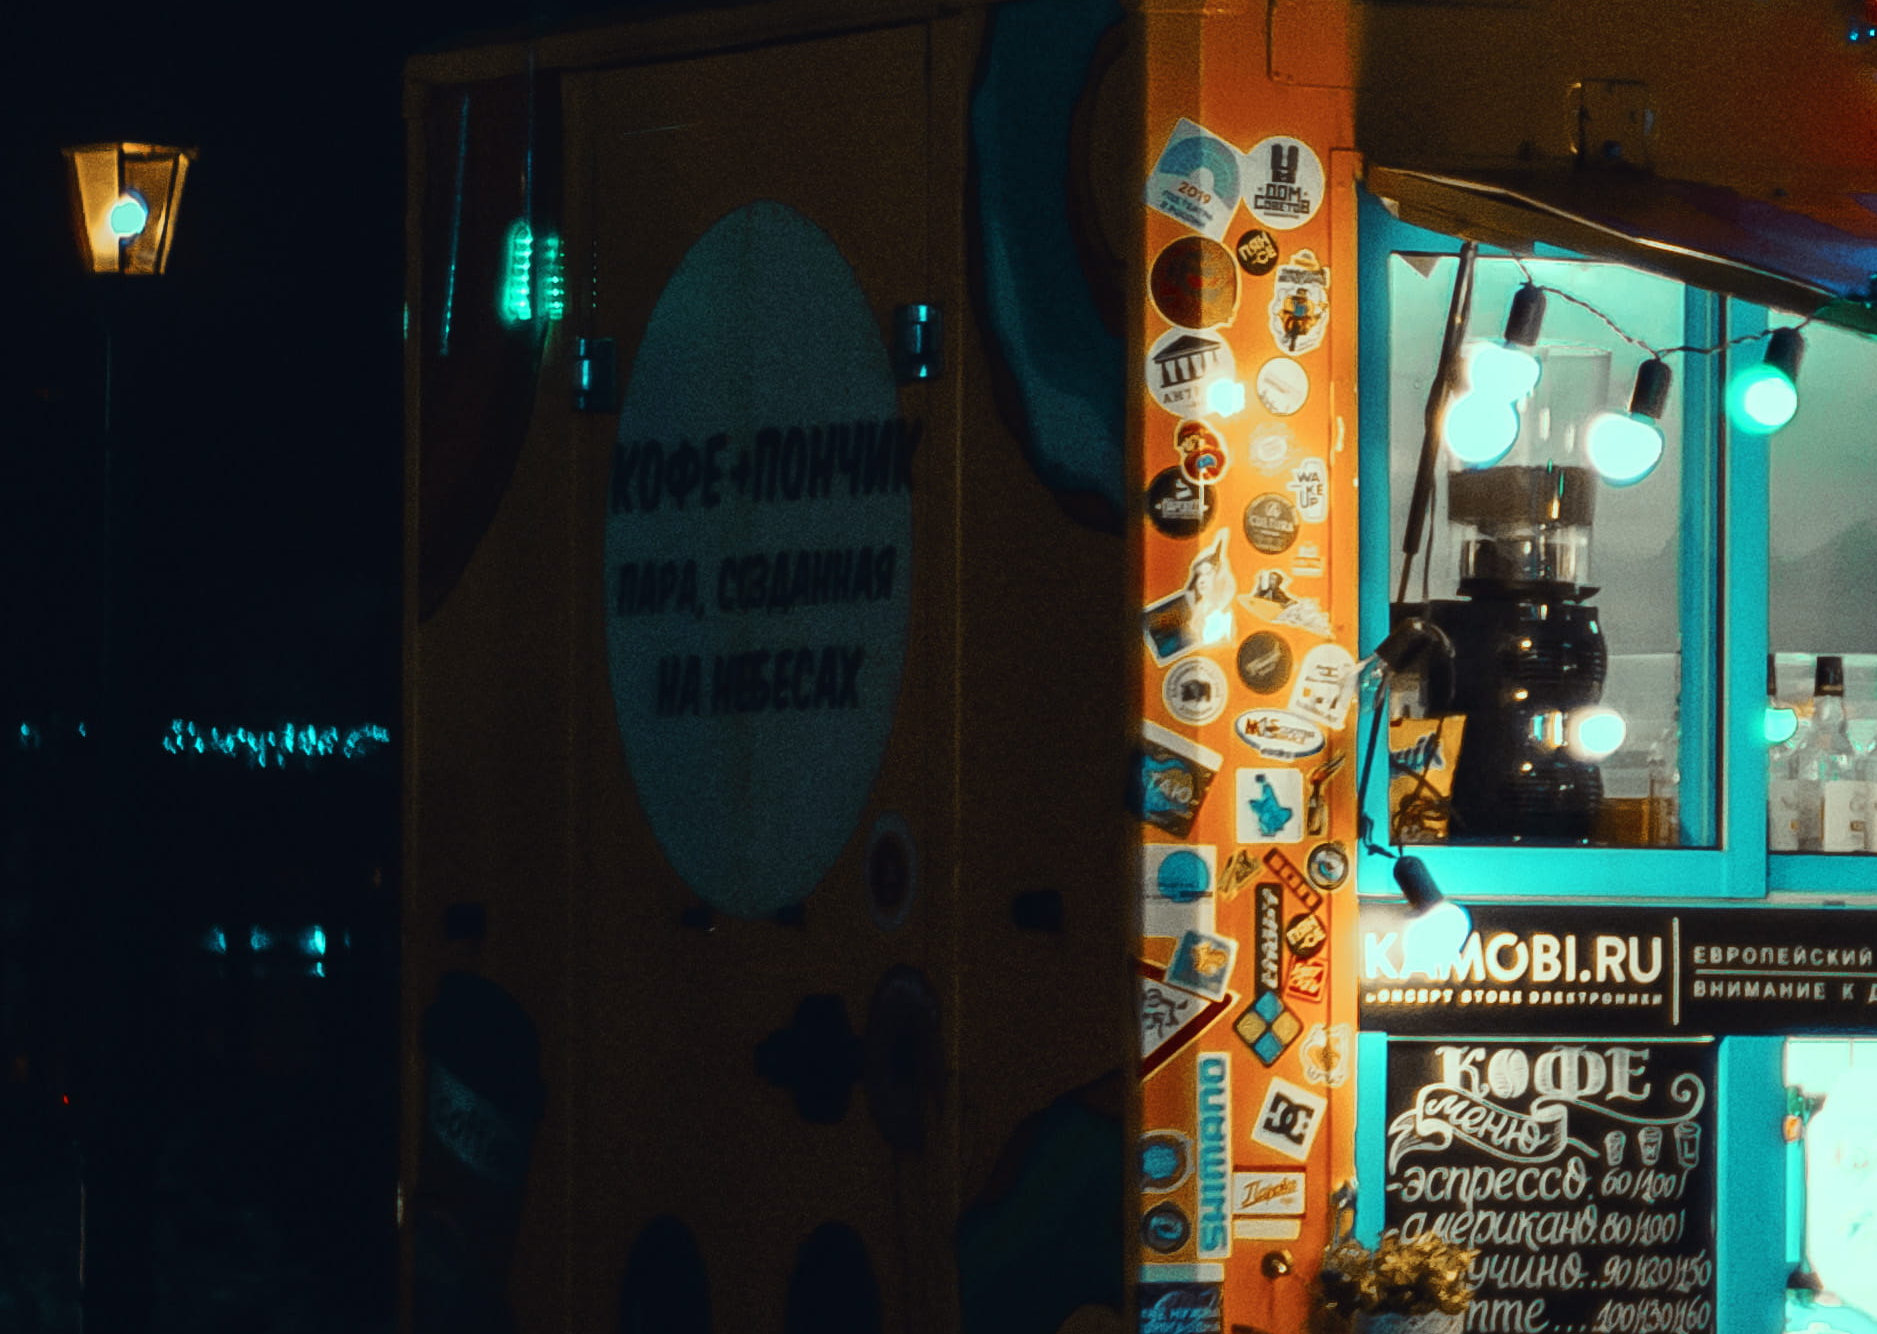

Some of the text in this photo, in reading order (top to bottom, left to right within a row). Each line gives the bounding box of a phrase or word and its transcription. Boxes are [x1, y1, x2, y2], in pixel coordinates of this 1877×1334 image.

[1265, 183, 1302, 201] ДОМ
[1693, 945, 1873, 965] ЕВРОПЕЙСКИЙ
[1460, 989, 1524, 1005] STORE
[1693, 980, 1826, 999] ВНИМАНИЕ
[1842, 983, 1855, 1000] К
[1434, 1044, 1652, 1101] КОФЕ
[1425, 1094, 1550, 1154] меню
[1200, 1058, 1226, 1252] SHIMANO
